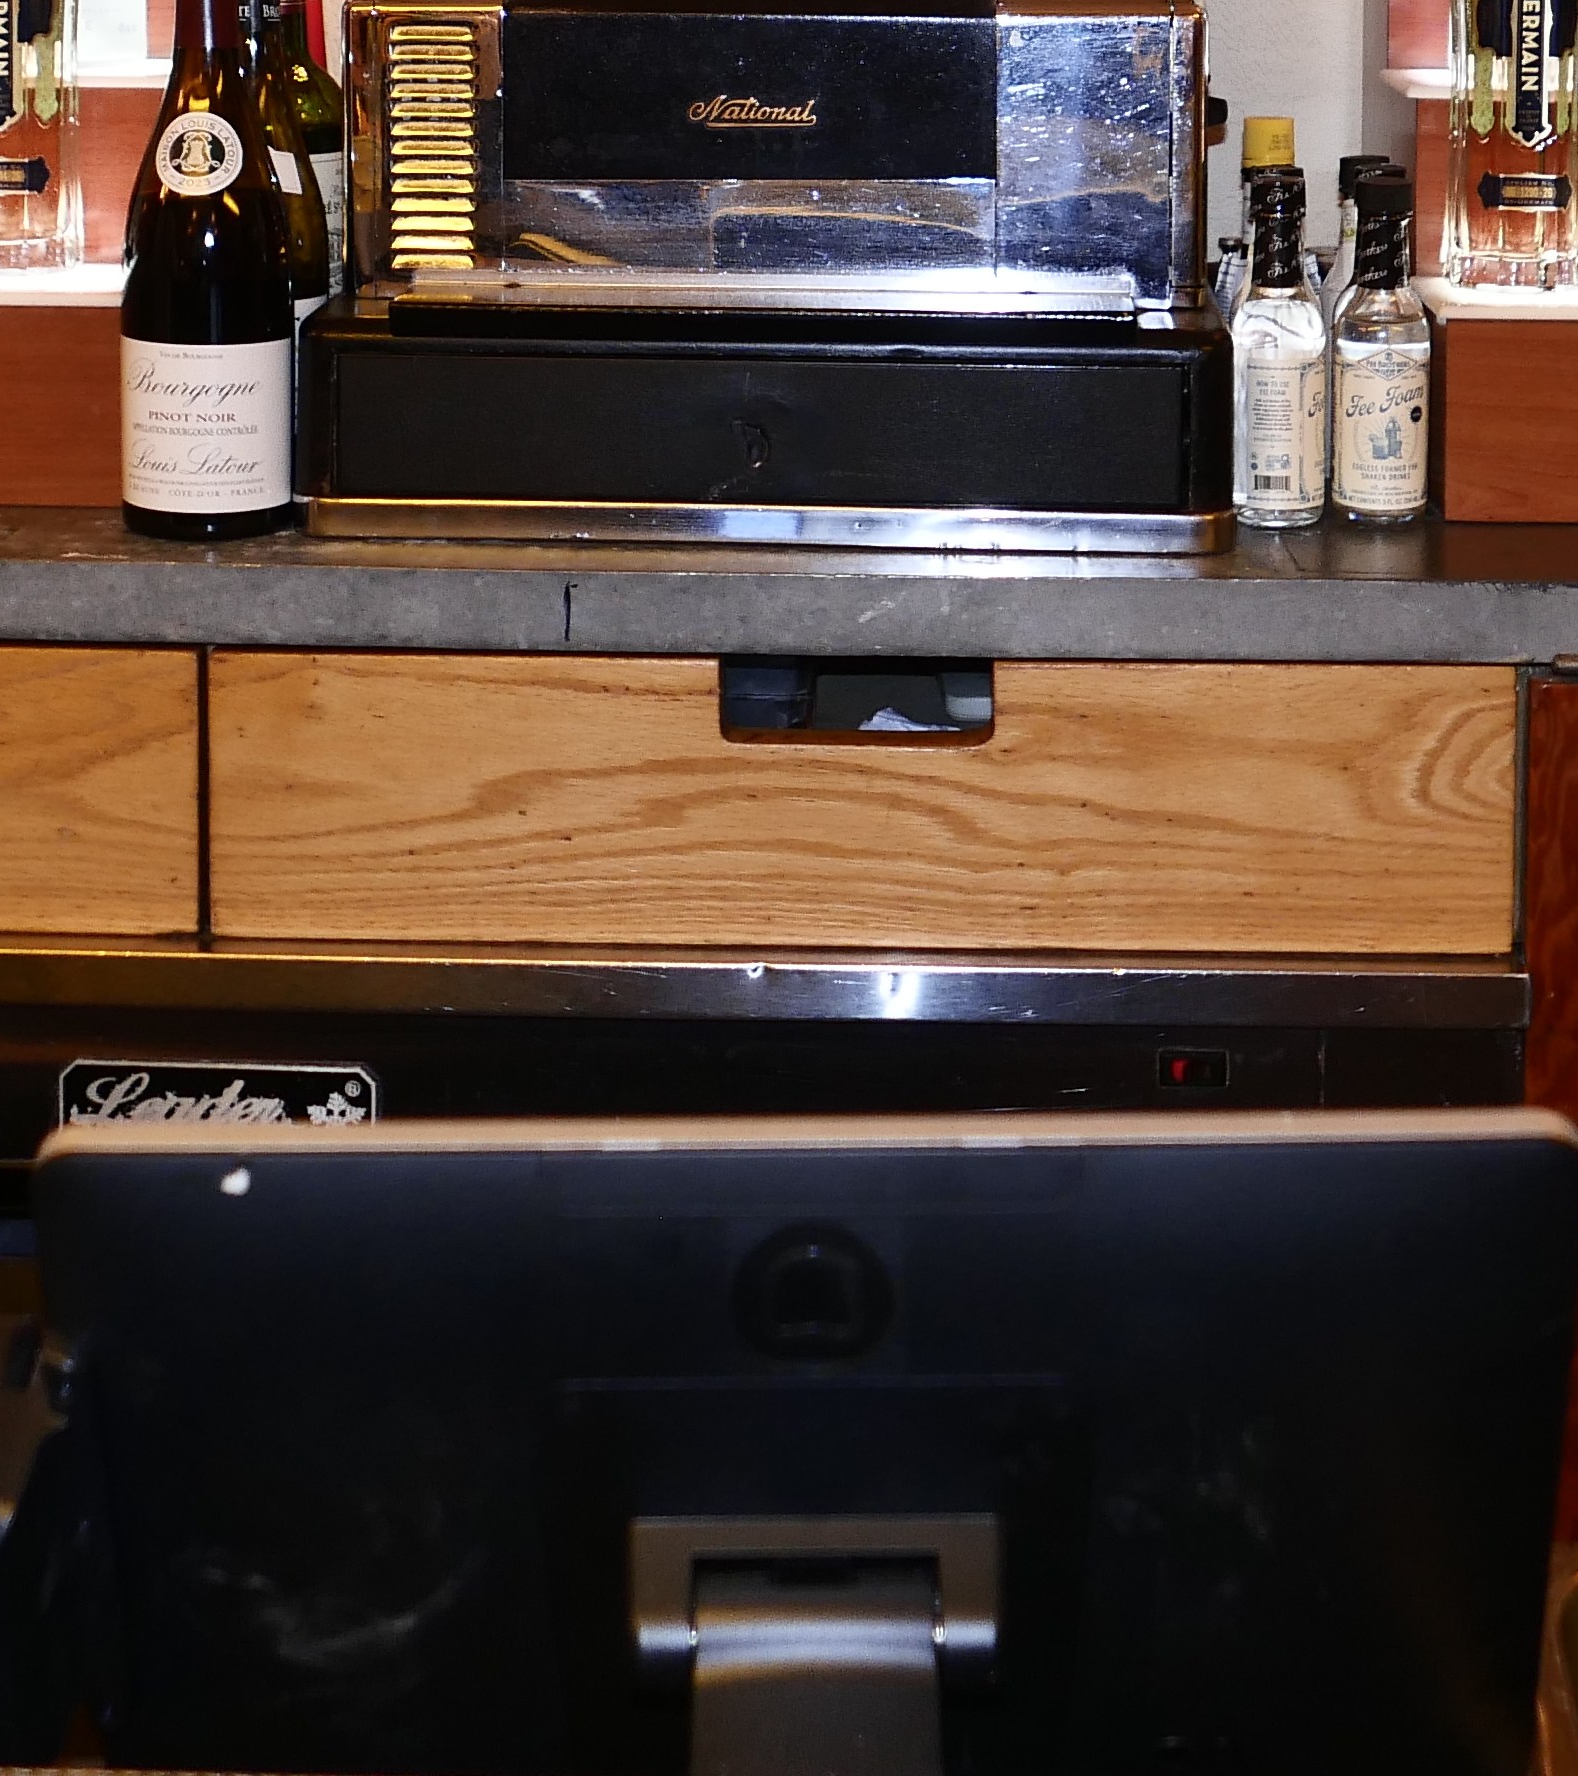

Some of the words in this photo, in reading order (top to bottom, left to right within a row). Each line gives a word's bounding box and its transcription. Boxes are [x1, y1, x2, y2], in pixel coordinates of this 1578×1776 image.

[687, 93, 818, 129] National
[127, 358, 261, 407] Bourgogne
[148, 410, 189, 422] PINOT
[196, 411, 236, 422] NOIR
[1345, 394, 1377, 417] Fee
[127, 437, 177, 474] Louis
[179, 441, 264, 475] Latour
